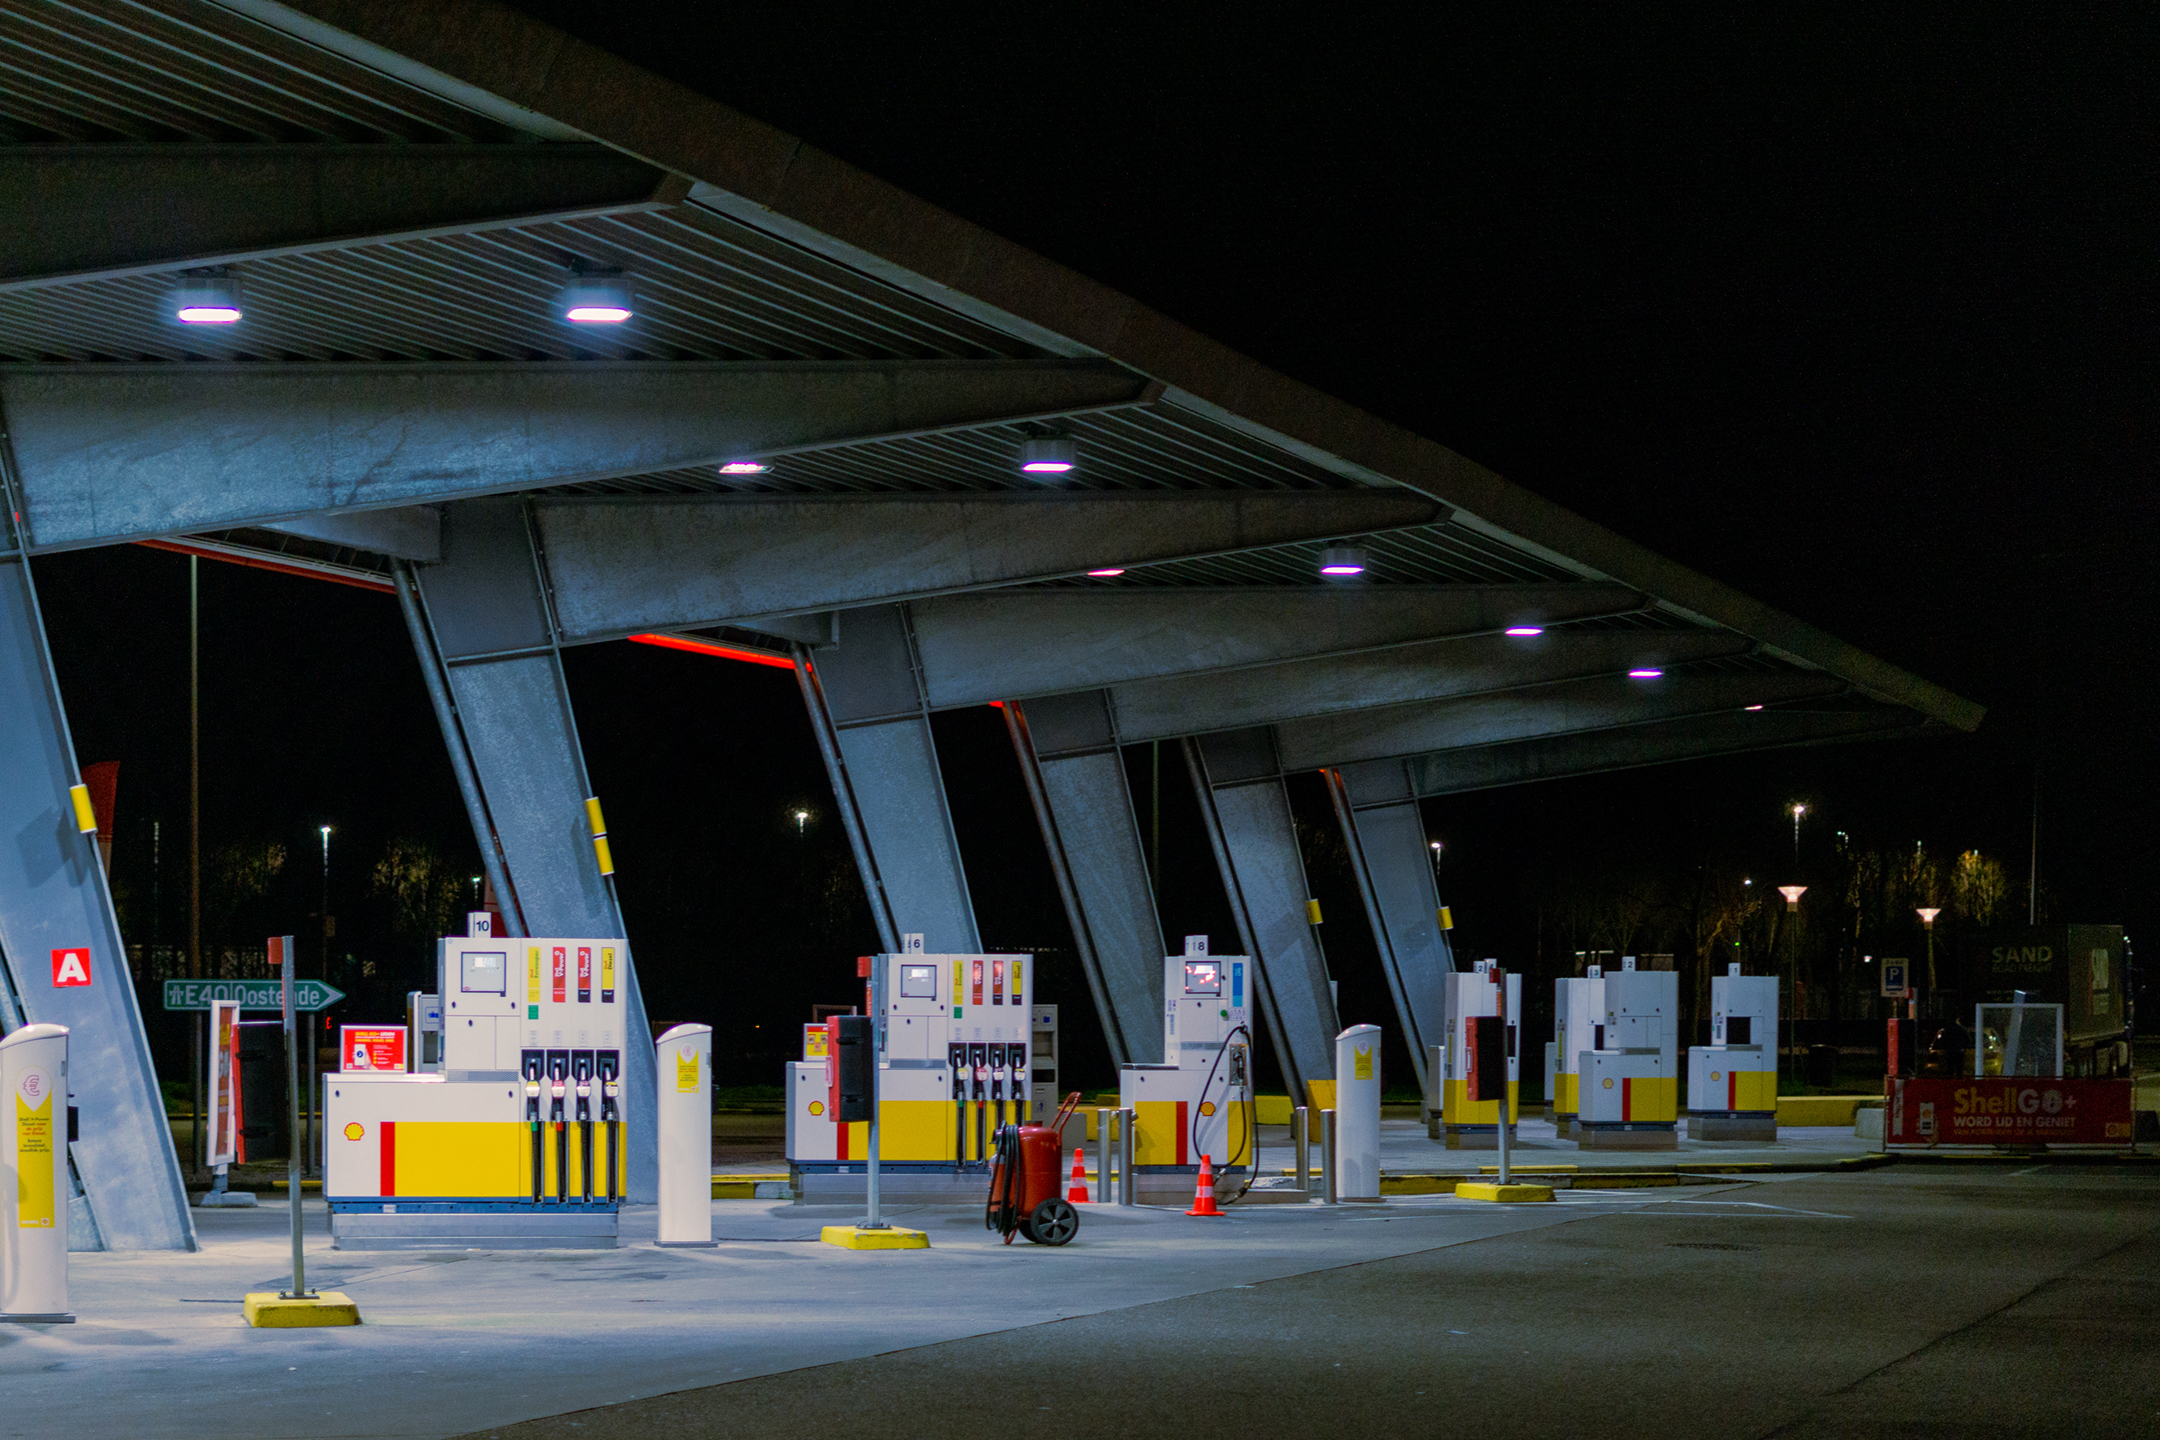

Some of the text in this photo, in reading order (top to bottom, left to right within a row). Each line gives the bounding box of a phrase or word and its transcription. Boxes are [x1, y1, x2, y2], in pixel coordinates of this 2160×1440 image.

[476, 920, 490, 932] 10
[914, 939, 921, 948] 6
[1198, 941, 1205, 951] 8
[1992, 946, 2053, 963] SAND
[57, 953, 88, 983] A
[1890, 968, 1899, 981] P
[186, 985, 320, 1005] E40 Oostede
[1953, 1116, 2077, 1127] WORD LID EN GENIET
